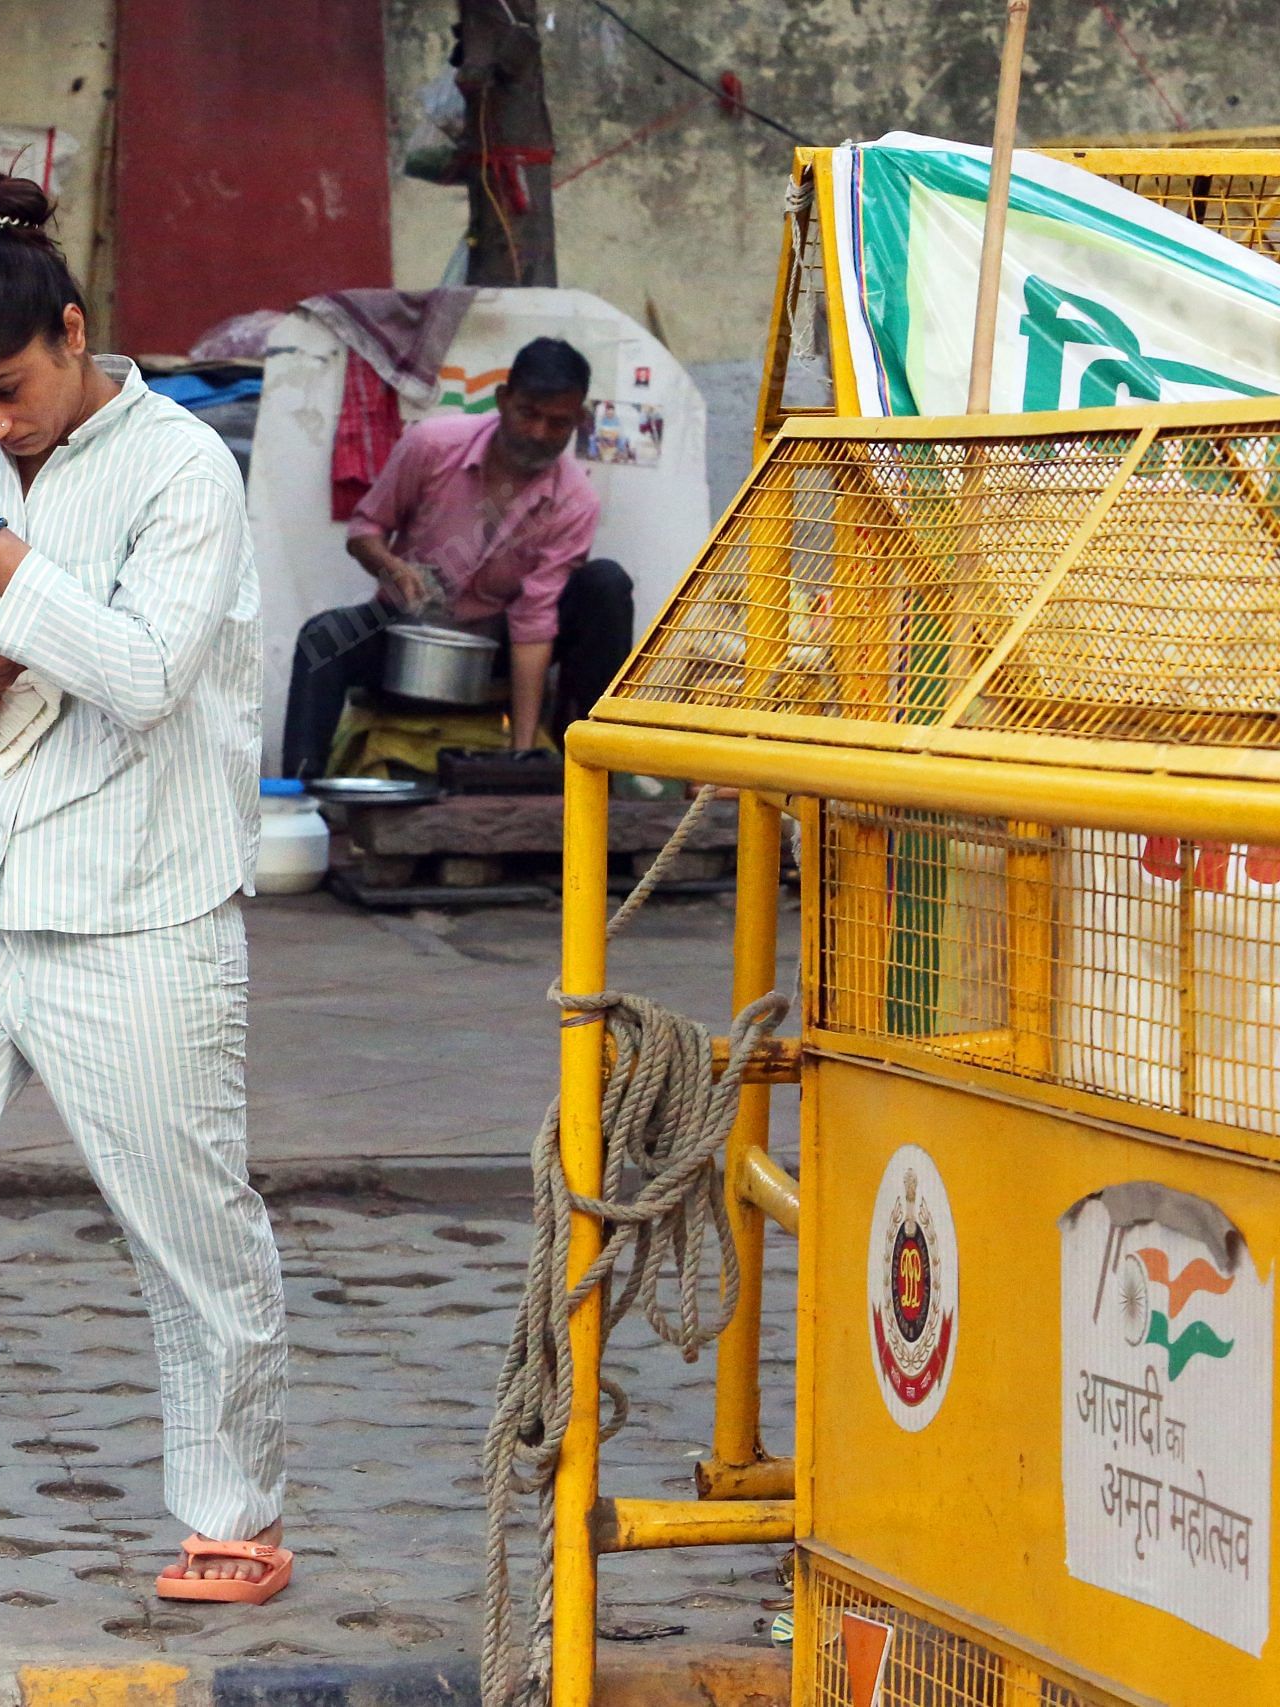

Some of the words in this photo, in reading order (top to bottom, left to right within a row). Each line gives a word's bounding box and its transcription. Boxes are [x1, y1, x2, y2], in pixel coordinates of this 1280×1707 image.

[1077, 1365, 1163, 1456] आज़ादी
[1164, 1417, 1186, 1464] का
[1101, 1463, 1163, 1561] अमृत
[1169, 1469, 1253, 1580] महोत्सव
